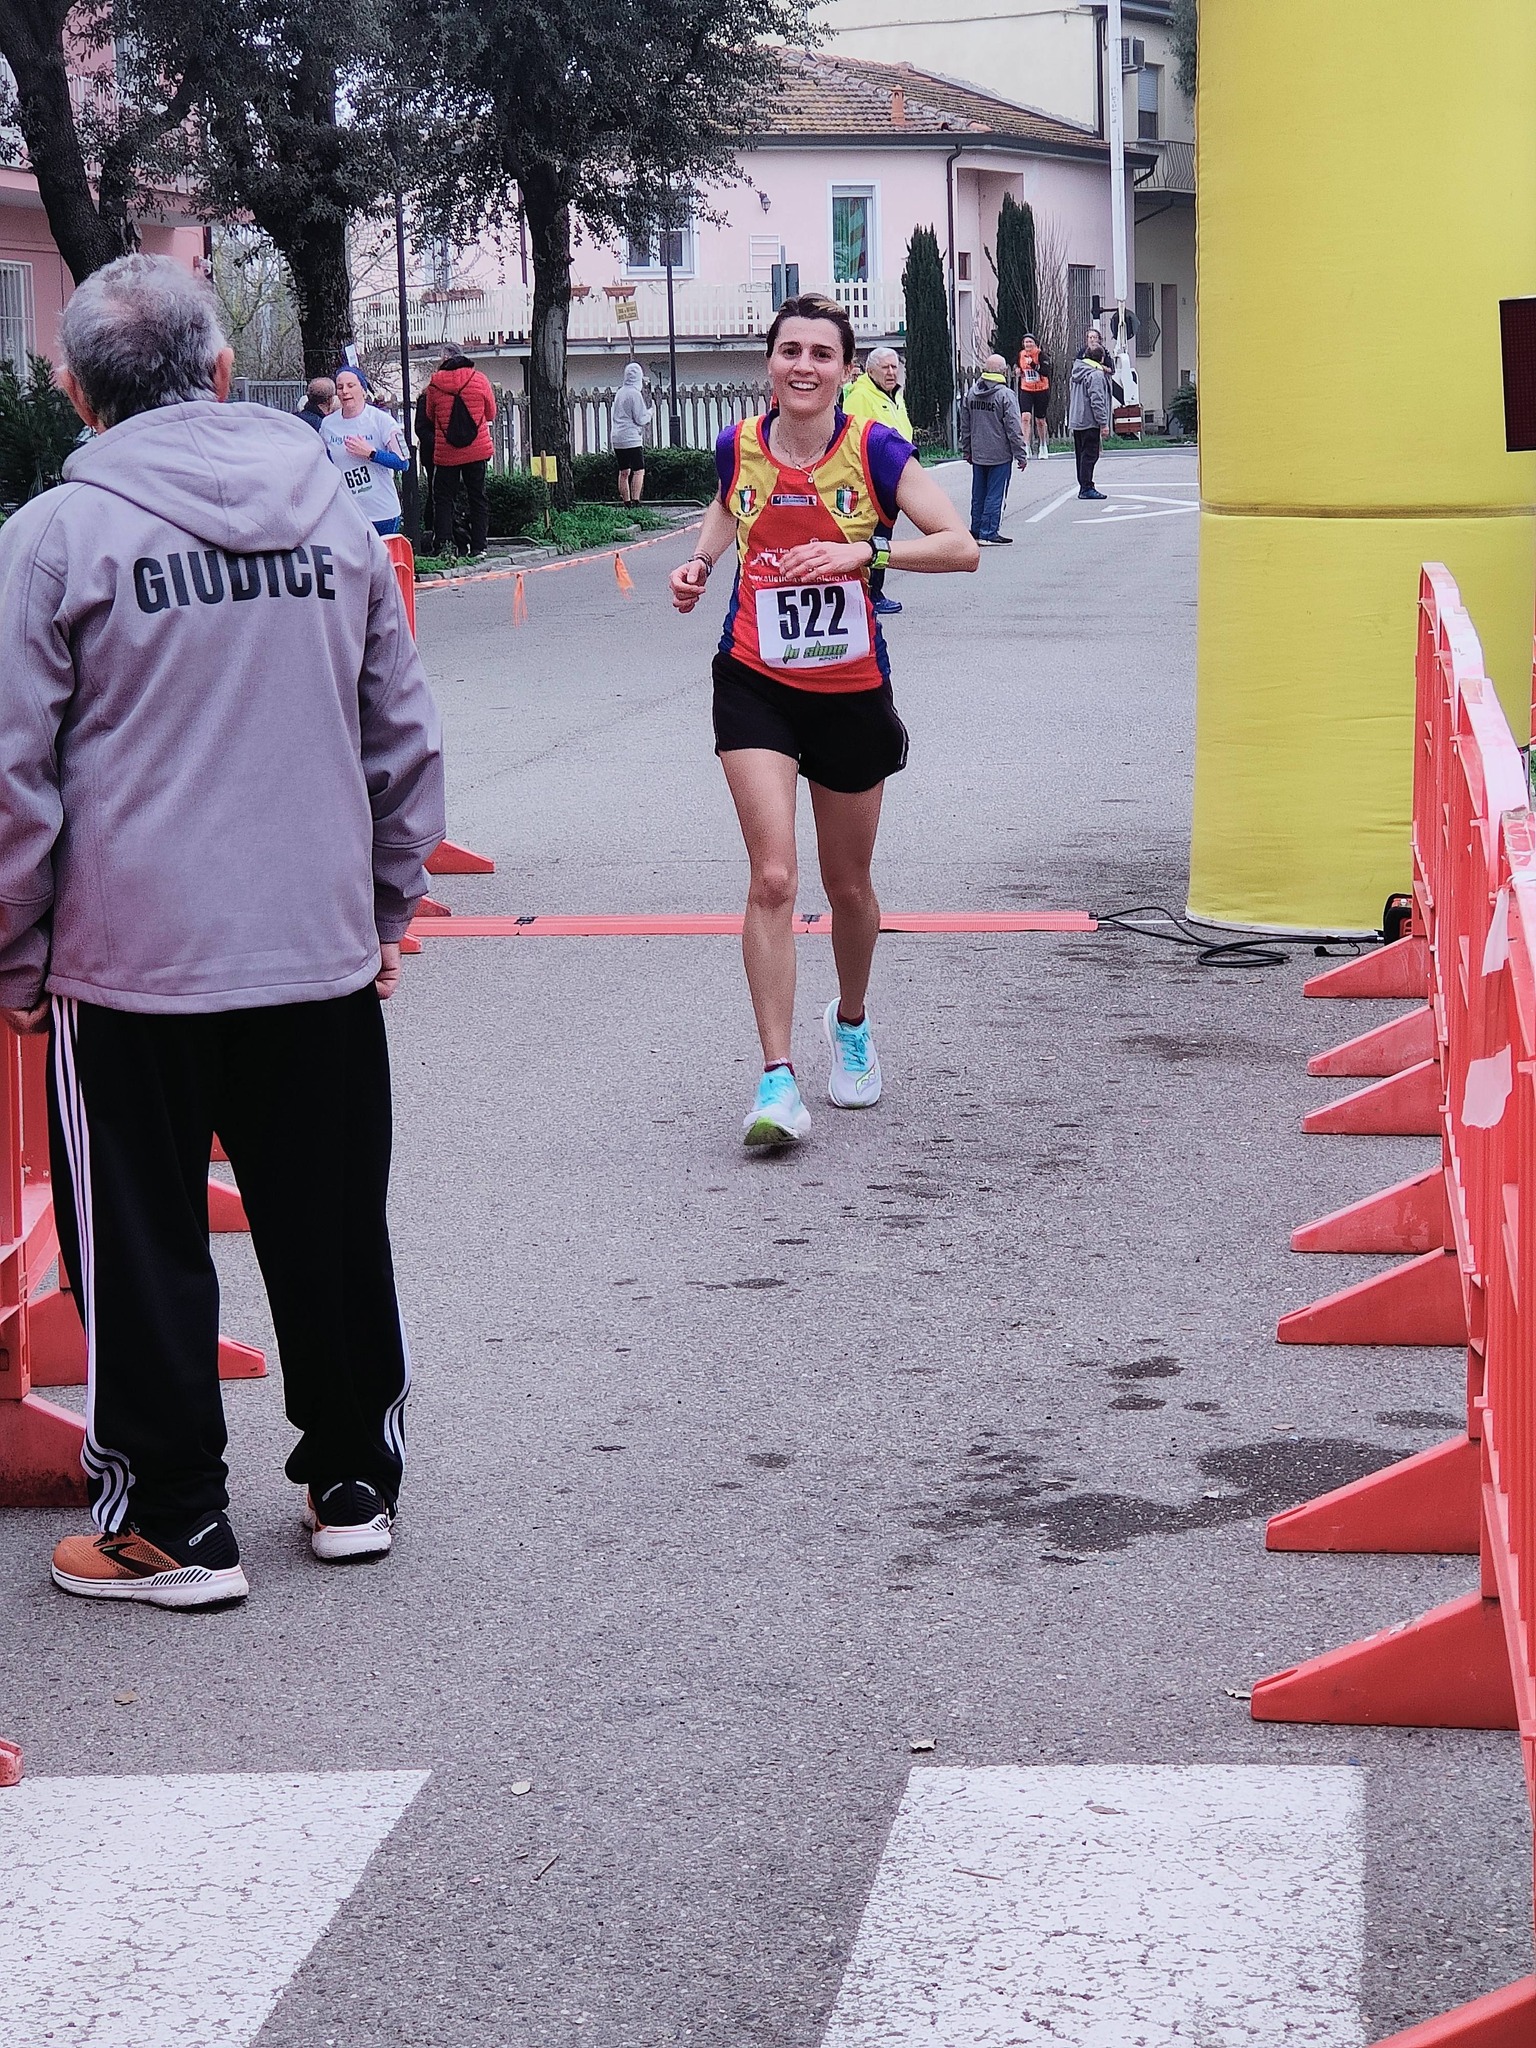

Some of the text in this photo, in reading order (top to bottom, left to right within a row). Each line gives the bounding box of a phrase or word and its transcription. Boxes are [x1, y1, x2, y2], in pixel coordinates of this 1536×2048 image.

[344, 465, 371, 488] 653
[133, 544, 336, 614] GIUDICE
[777, 586, 848, 640] 522
